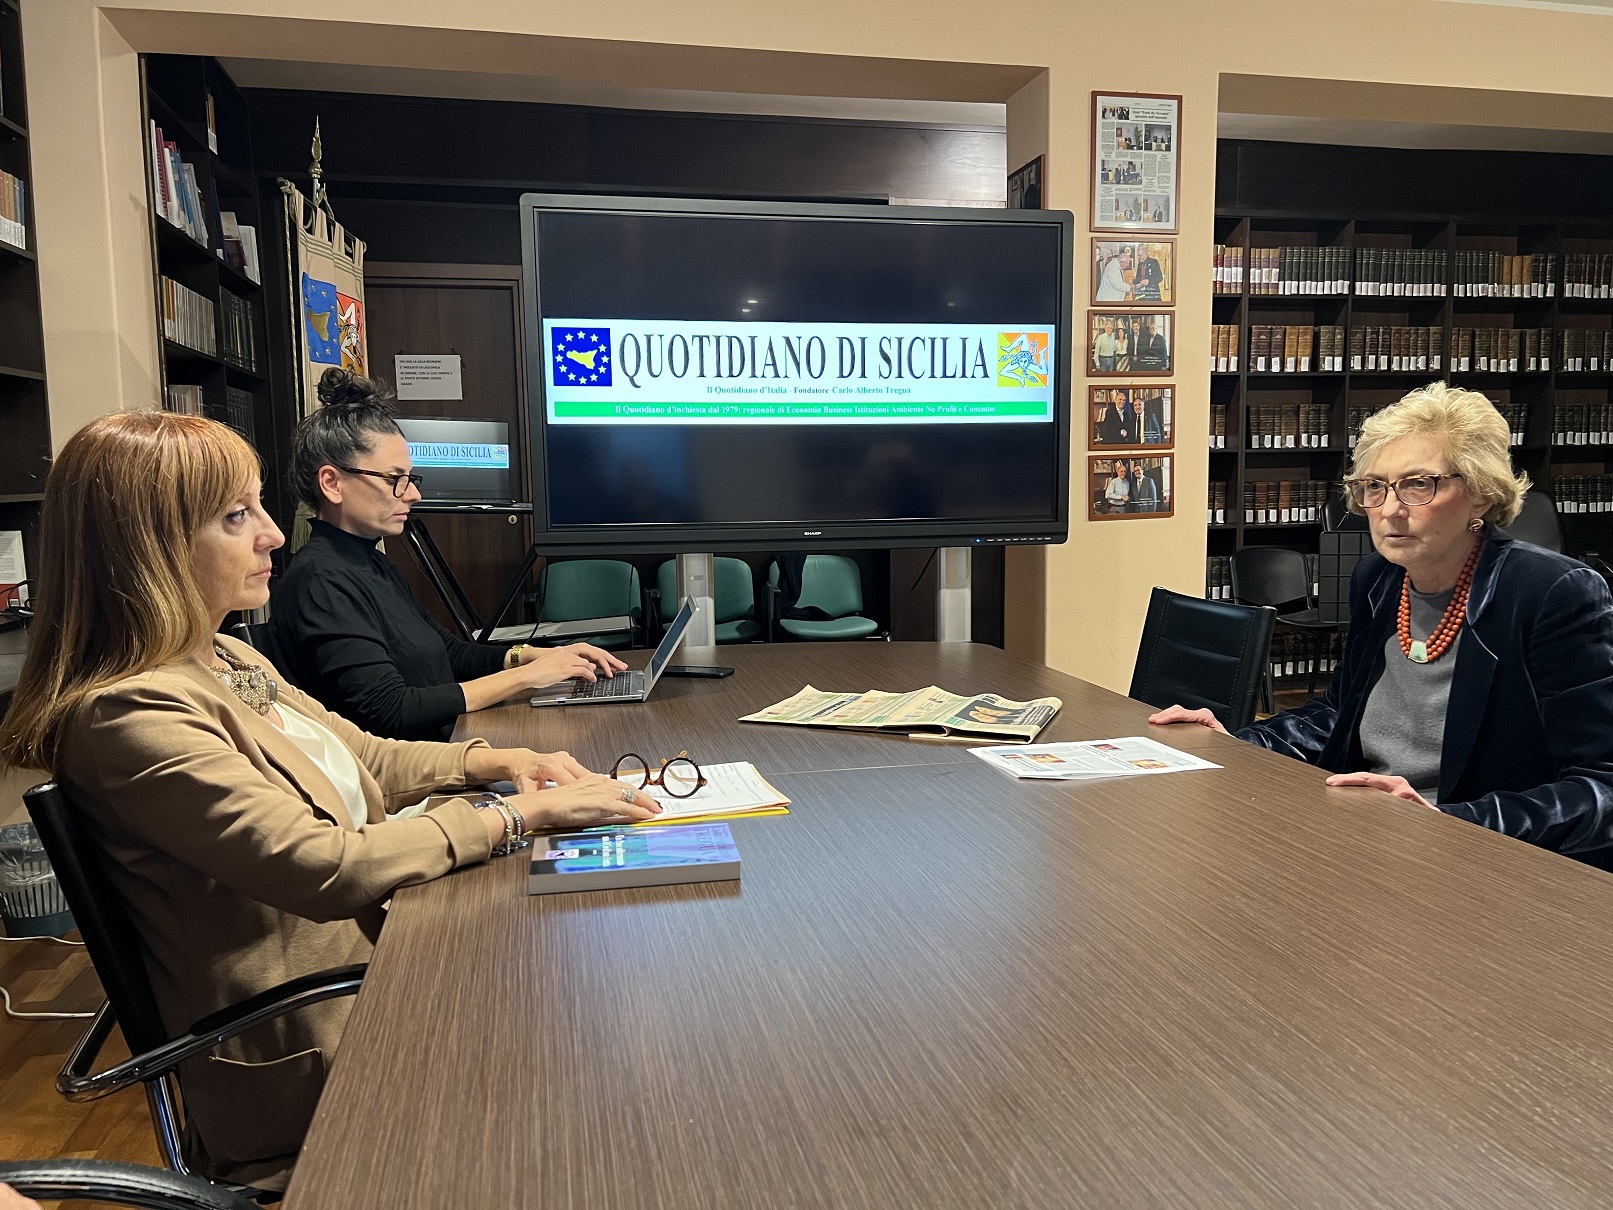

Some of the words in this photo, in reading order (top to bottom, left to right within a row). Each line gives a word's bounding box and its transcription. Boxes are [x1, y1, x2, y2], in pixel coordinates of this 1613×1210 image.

[618, 332, 826, 388] QUOTIDIANO
[836, 336, 869, 379] DI
[878, 336, 990, 380] SICILIA
[714, 386, 758, 394] Quotidiano
[885, 386, 911, 395] Tregua
[623, 406, 664, 414] Quotidiano
[743, 406, 775, 415] regionale
[777, 406, 784, 414] di
[409, 446, 448, 457] OTIDIANO
[450, 446, 459, 457] DI
[461, 447, 491, 458] SICILIA
